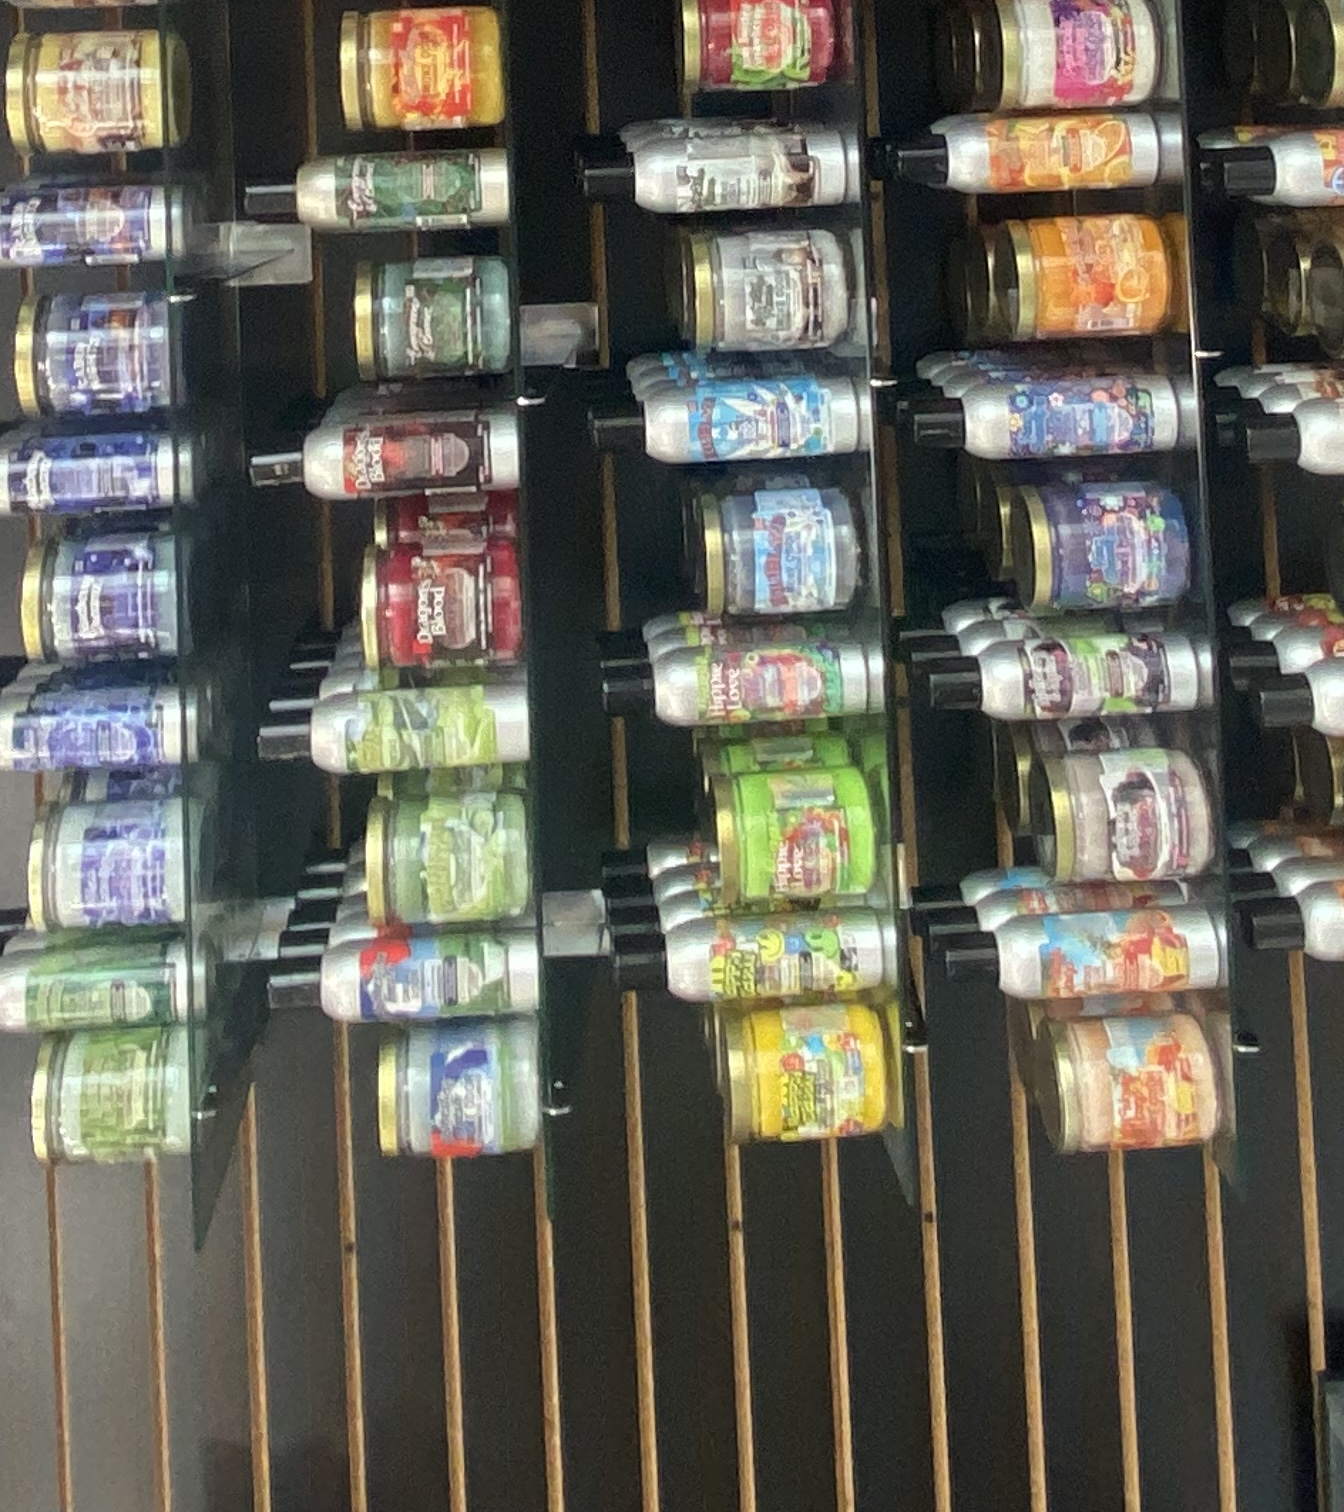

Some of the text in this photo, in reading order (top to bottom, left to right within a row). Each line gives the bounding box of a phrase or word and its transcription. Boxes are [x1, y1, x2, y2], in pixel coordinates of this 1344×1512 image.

[367, 436, 385, 483] Blood
[429, 586, 446, 635] Blood
[709, 662, 727, 717] Hippie
[726, 668, 742, 710] Love
[775, 840, 791, 892] Hippie
[789, 844, 803, 887] Love
